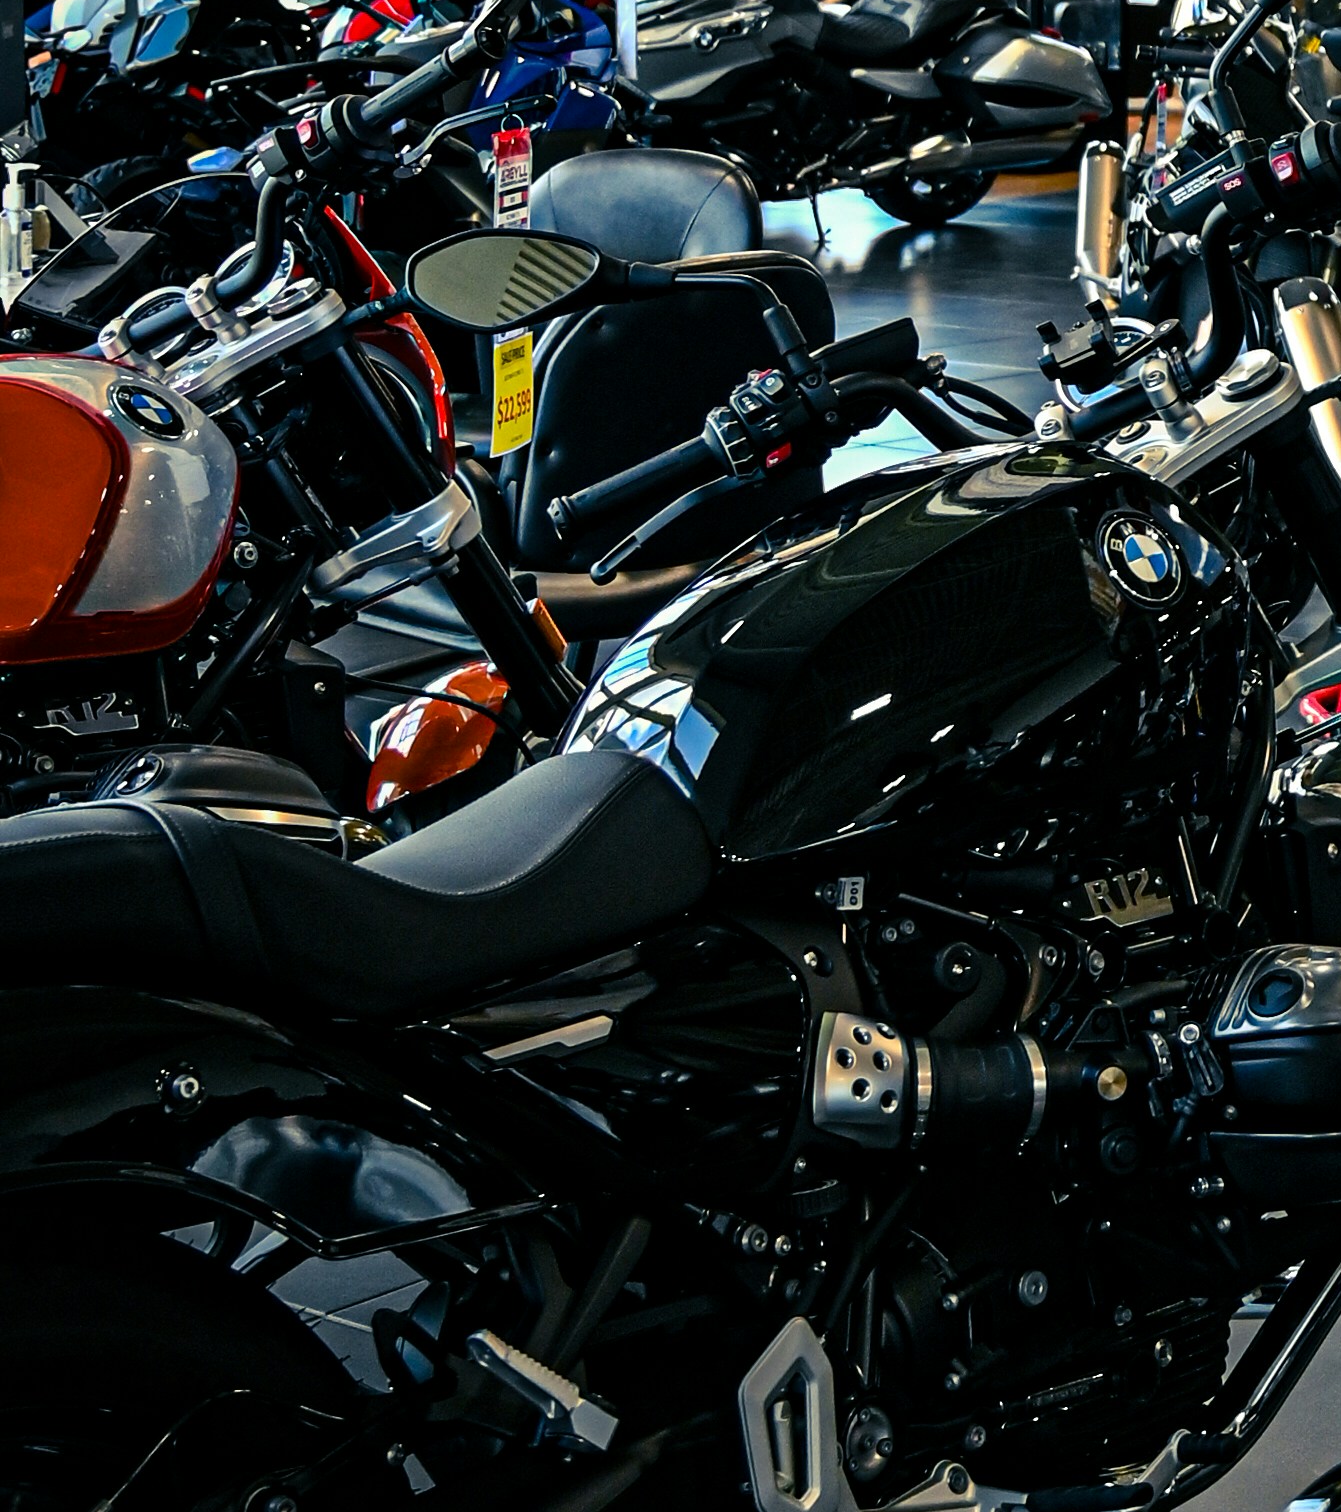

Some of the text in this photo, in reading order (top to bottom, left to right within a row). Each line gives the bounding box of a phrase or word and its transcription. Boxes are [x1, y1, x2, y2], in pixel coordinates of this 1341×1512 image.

[1223, 178, 1242, 192] SOS
[497, 388, 531, 429] $22,599
[1084, 868, 1158, 917] R12
